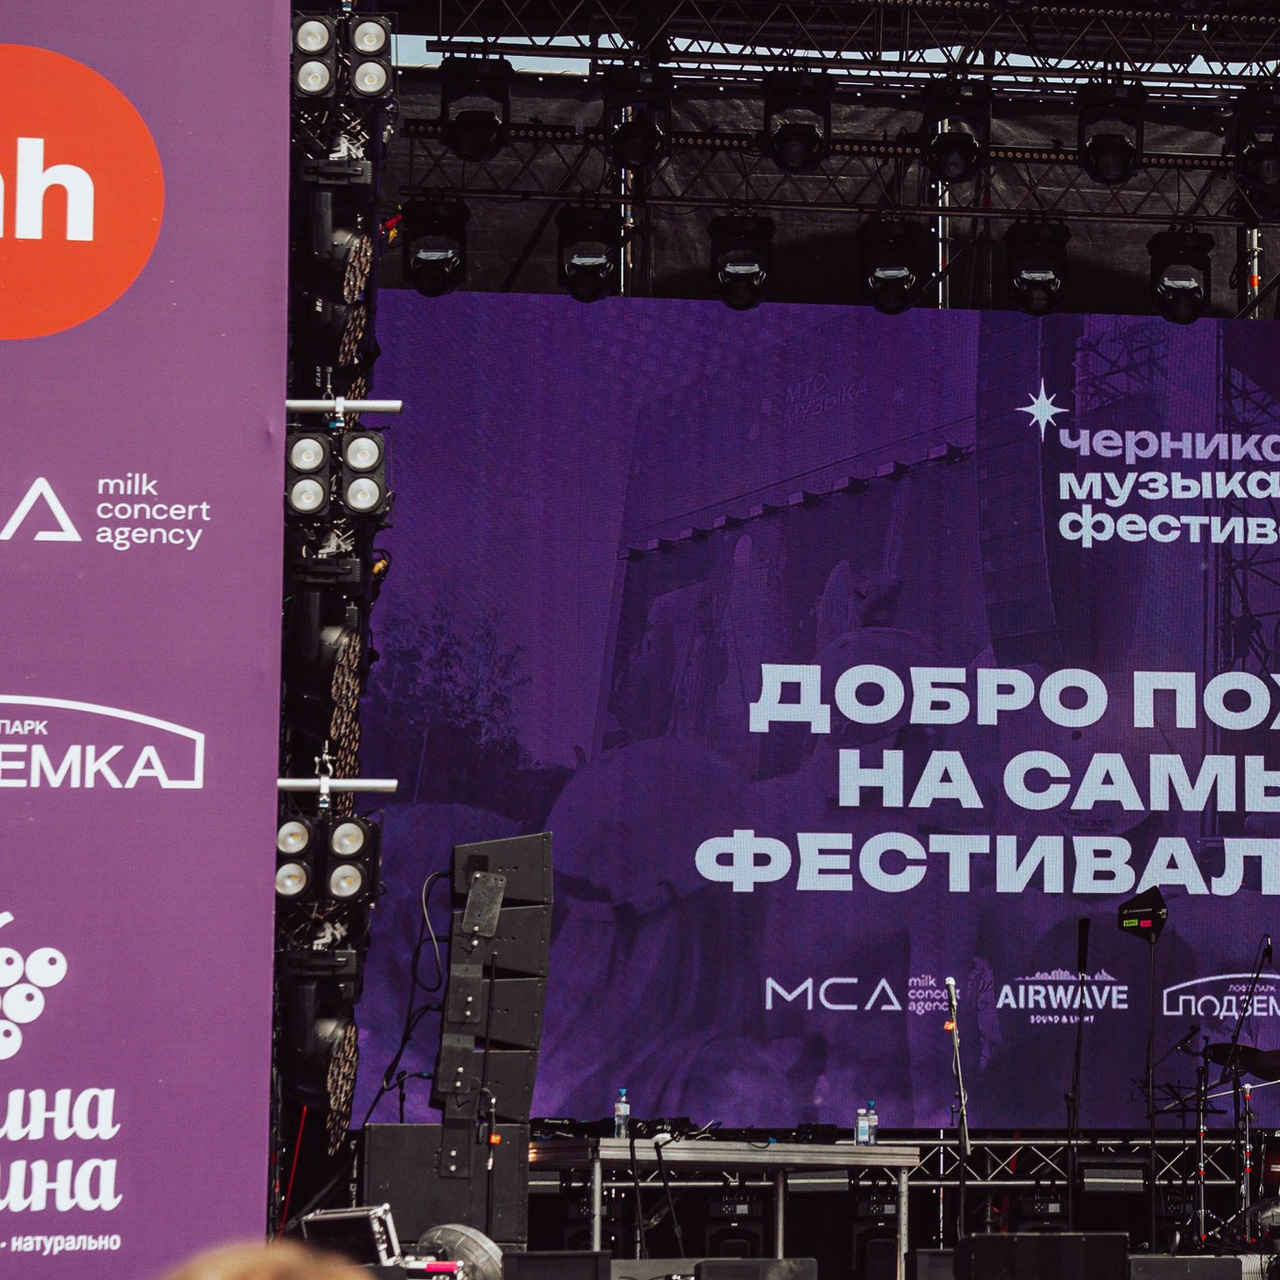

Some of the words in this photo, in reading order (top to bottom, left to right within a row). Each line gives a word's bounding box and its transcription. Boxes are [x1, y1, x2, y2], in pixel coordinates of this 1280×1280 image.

[97, 472, 159, 496] milk
[95, 500, 212, 521] concert
[95, 525, 203, 552] agency
[748, 662, 1109, 735] ДОБРО
[838, 747, 985, 810] НА
[764, 976, 902, 1012] MCA
[907, 974, 937, 987] milk
[995, 984, 1129, 1010] AIRWAVE
[907, 1001, 951, 1016] agenc
[10, 1233, 122, 1257] натурально
